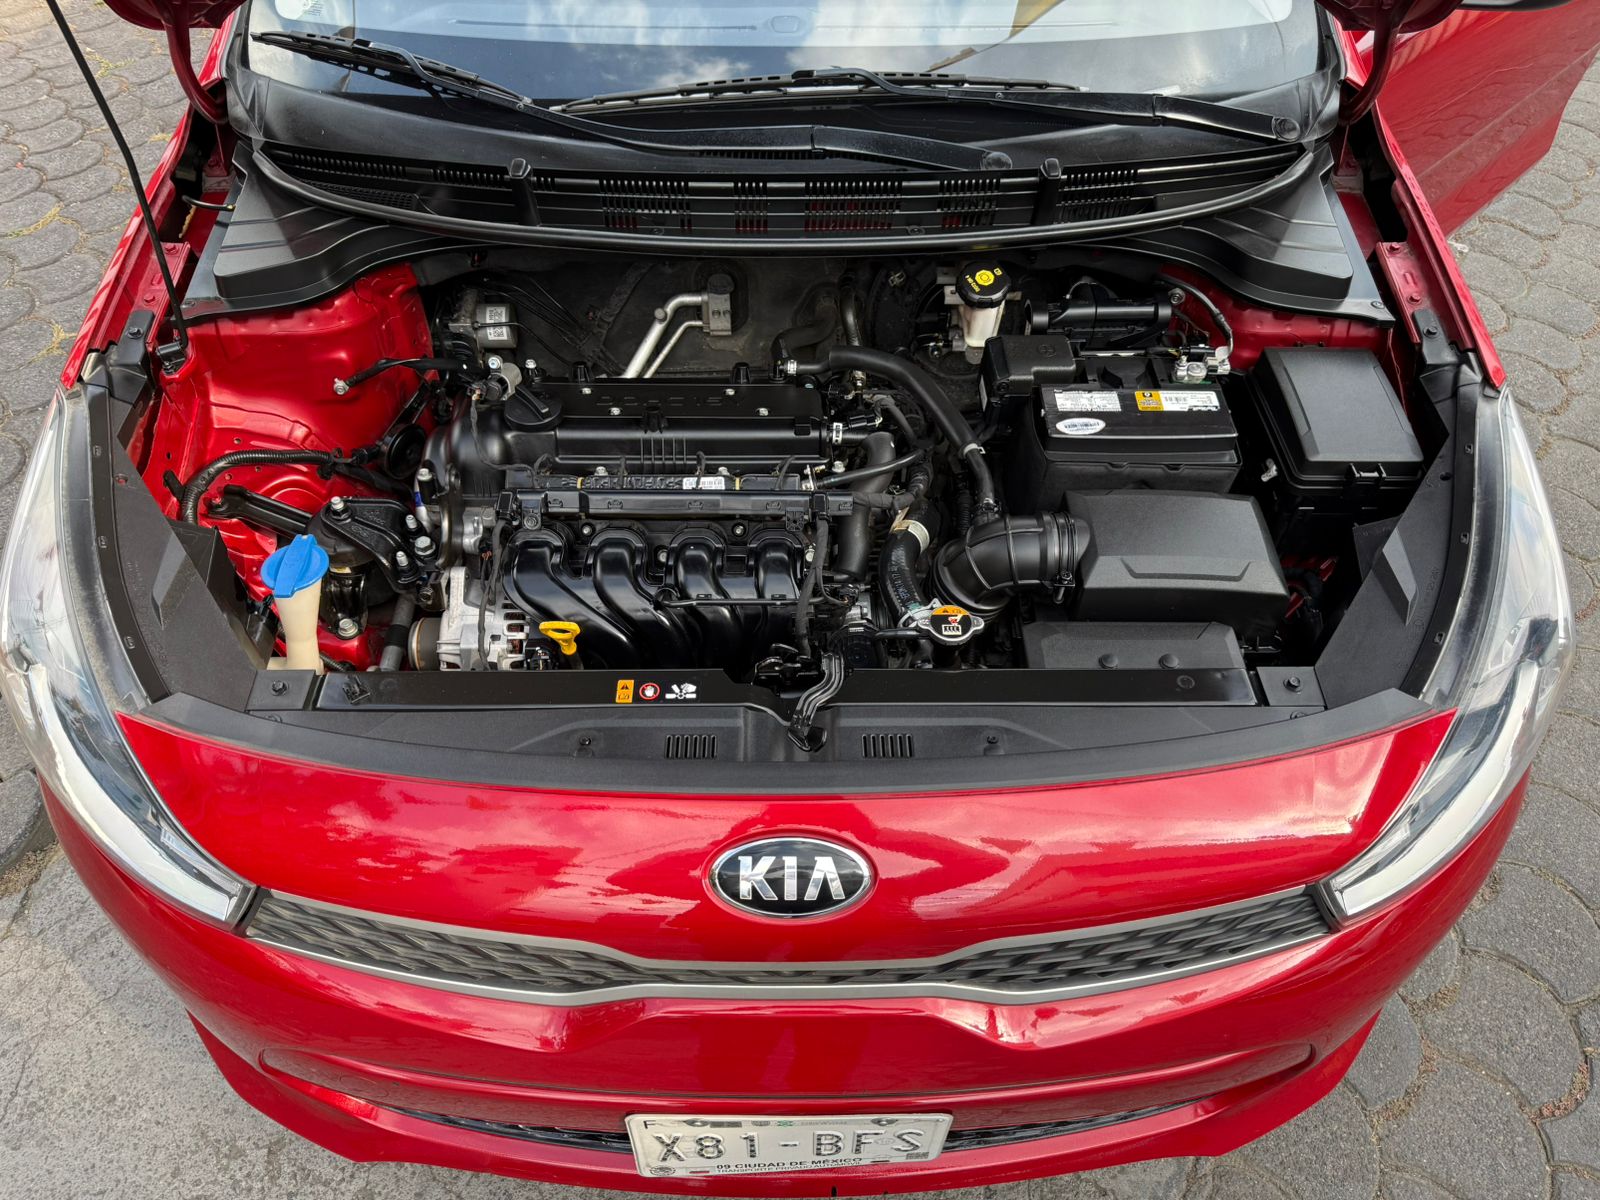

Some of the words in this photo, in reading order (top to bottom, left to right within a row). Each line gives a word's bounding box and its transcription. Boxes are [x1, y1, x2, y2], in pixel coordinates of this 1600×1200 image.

[738, 855, 846, 901] KIA
[652, 1128, 924, 1162] X81-BFS
[735, 1161, 786, 1169] CIUDAD
